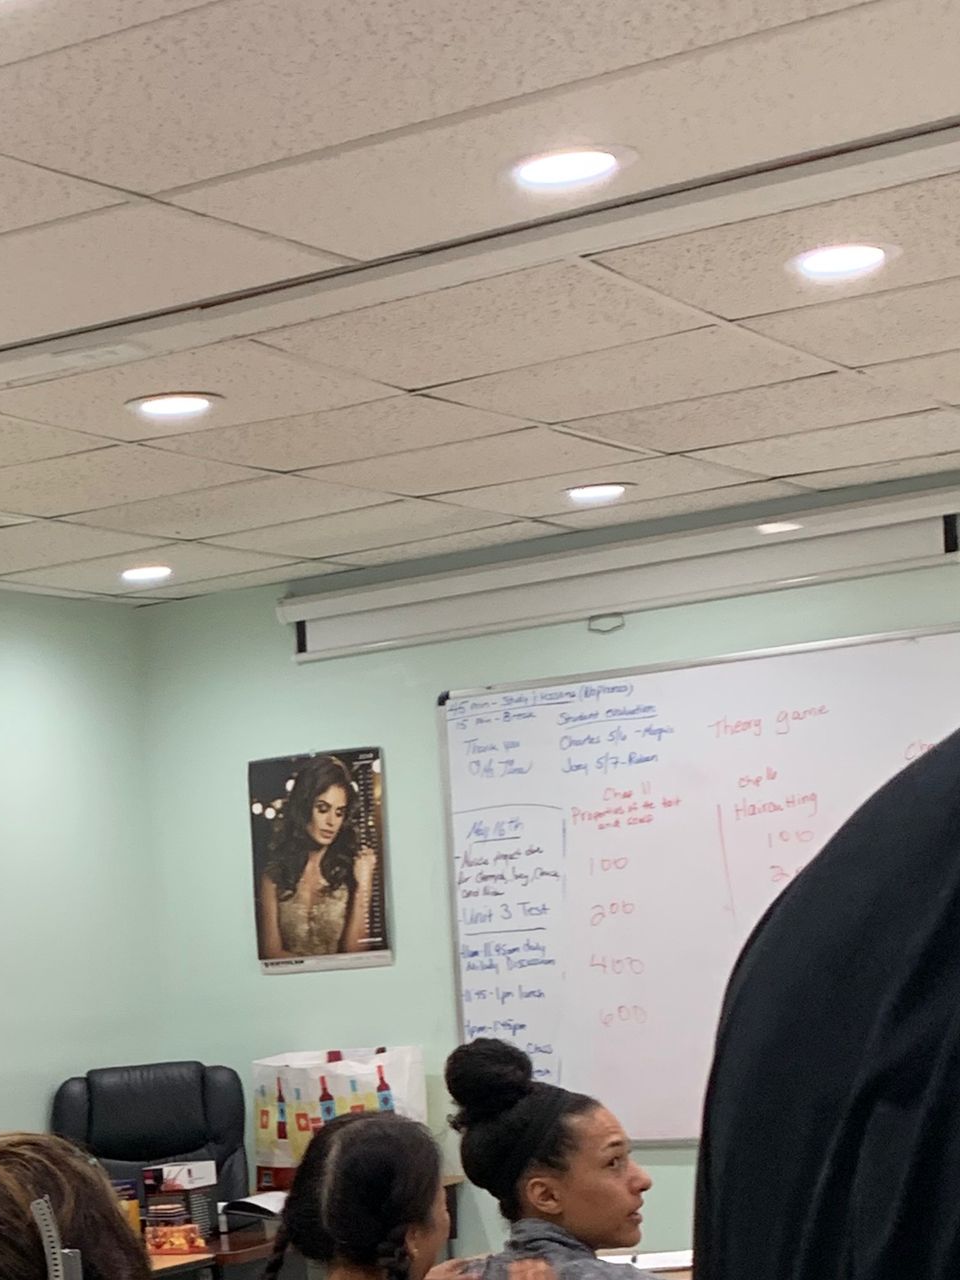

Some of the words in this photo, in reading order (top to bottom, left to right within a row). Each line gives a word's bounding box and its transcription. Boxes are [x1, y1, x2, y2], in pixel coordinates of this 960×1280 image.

[557, 711, 600, 725] Student
[707, 716, 762, 738] Theory
[775, 705, 829, 734] game
[464, 738, 498, 756] Thank
[767, 830, 814, 848] 100
[589, 856, 628, 877] 100
[500, 903, 513, 920] 3
[517, 901, 551, 917] Test
[590, 900, 635, 927] 200
[589, 953, 646, 976] 400
[598, 1003, 649, 1029] 600
